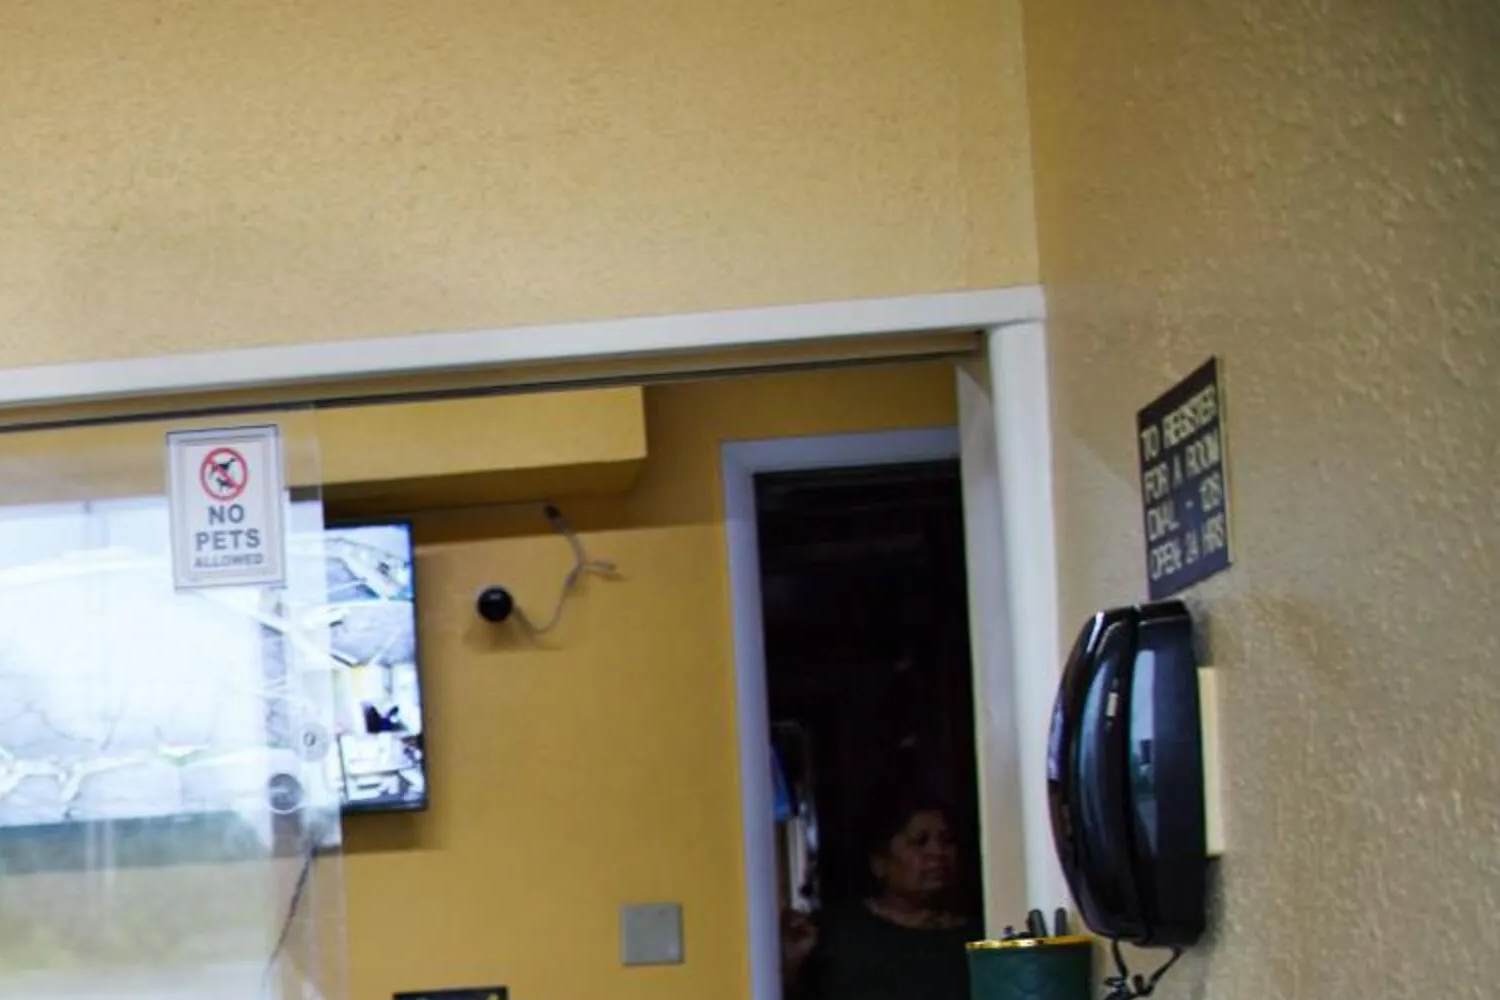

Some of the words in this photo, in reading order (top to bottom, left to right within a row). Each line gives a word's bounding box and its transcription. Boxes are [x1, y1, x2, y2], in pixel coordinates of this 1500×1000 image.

[1140, 424, 1160, 462] TO
[1144, 461, 1170, 504] FOR
[1171, 452, 1184, 488] A
[1185, 427, 1220, 478] ROOM
[208, 504, 245, 525] NO
[1148, 500, 1180, 542] DIAL
[195, 528, 260, 551] PETS
[1150, 537, 1182, 581] OPEN
[1201, 512, 1226, 554] HRS
[194, 553, 264, 568] ALLOWED
